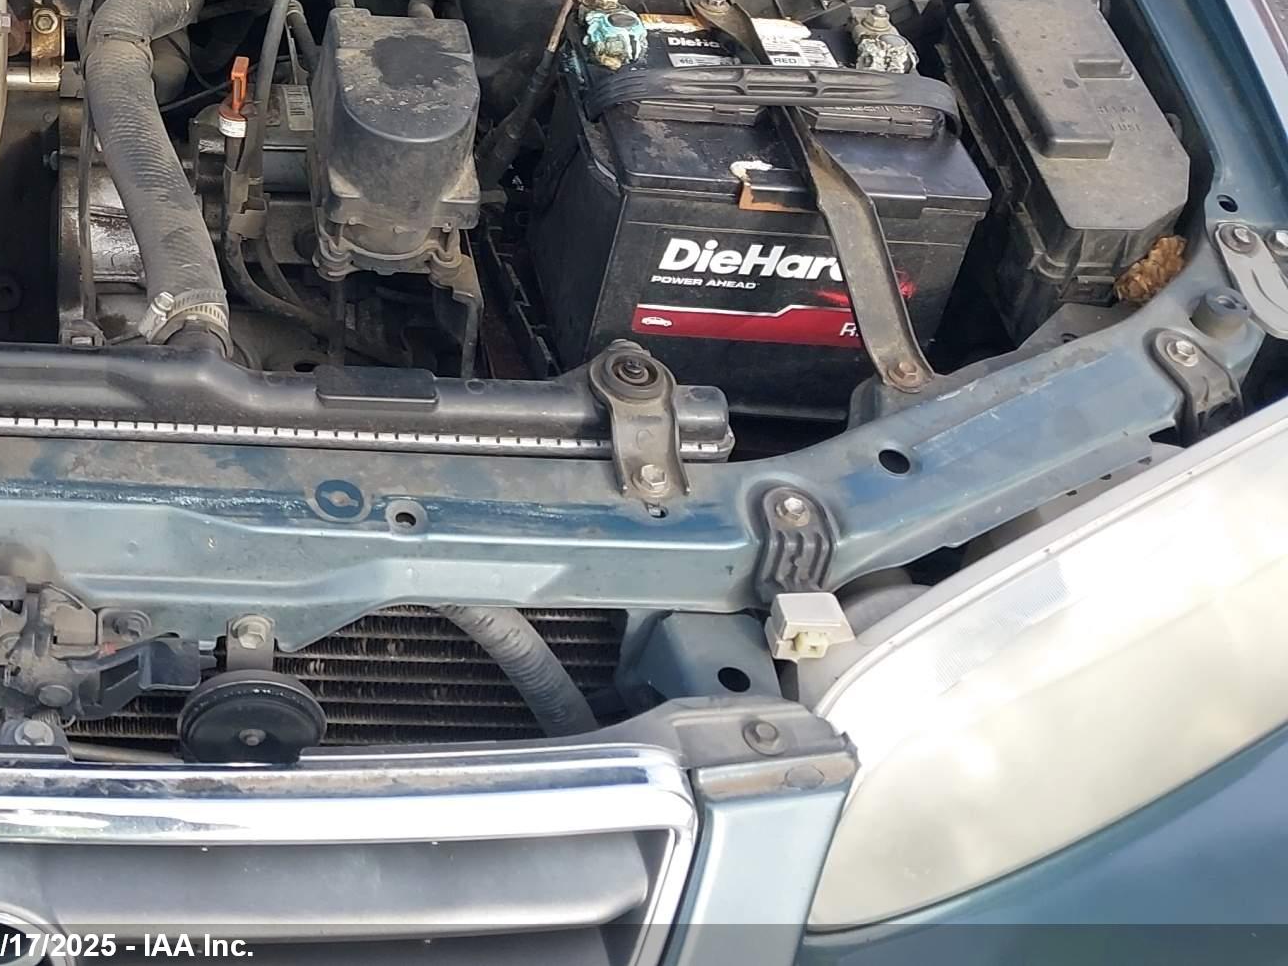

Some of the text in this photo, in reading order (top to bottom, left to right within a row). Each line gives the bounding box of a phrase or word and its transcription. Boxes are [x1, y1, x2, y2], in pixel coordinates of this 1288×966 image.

[773, 57, 798, 65] RED
[650, 274, 758, 290] POWER AHEAD
